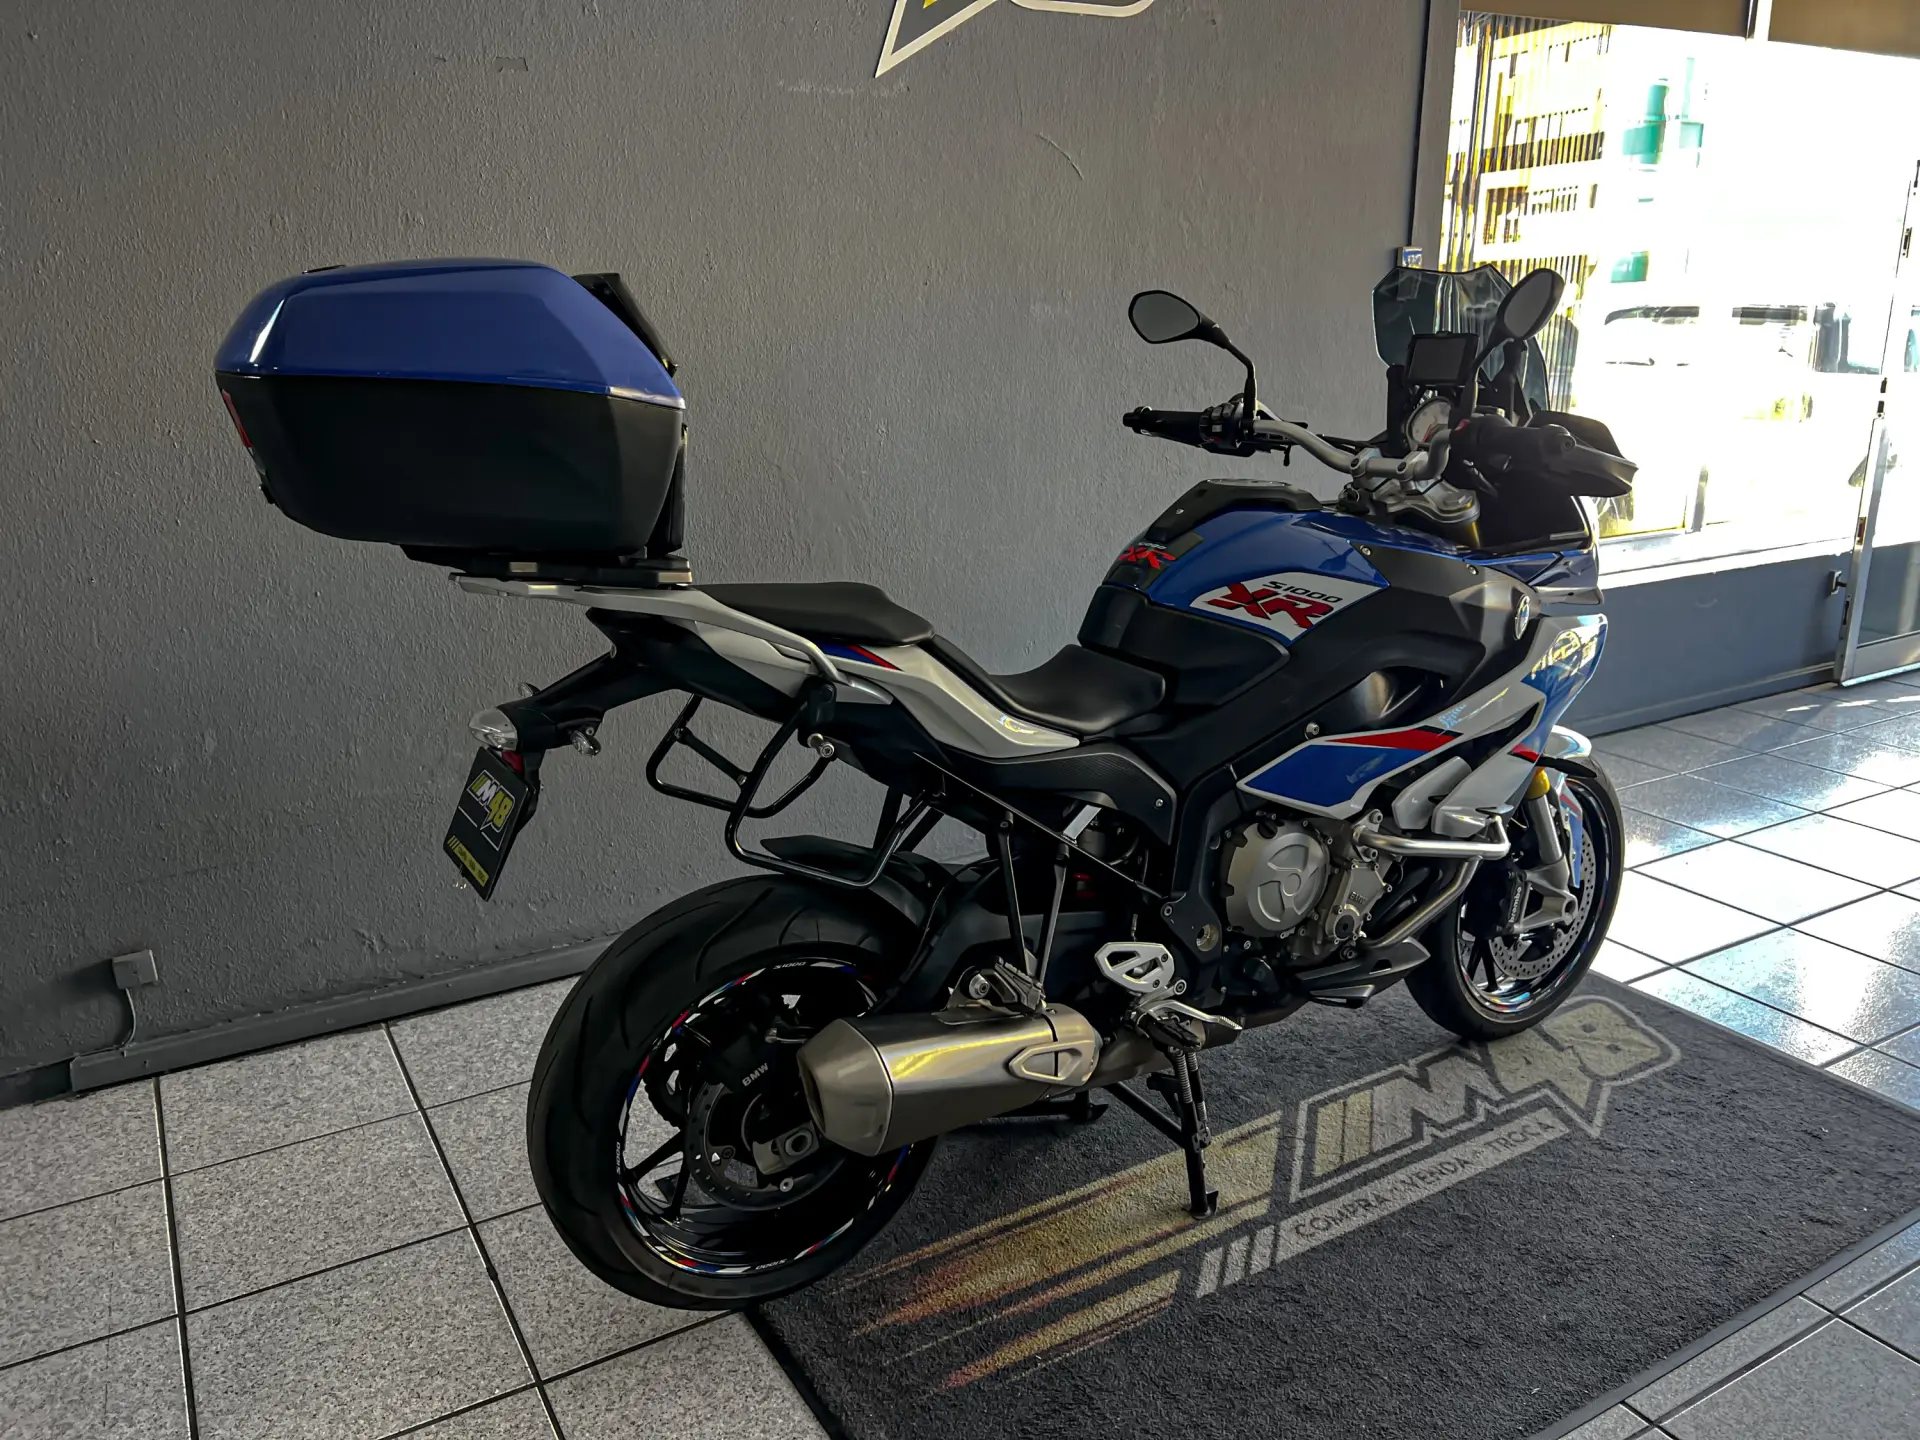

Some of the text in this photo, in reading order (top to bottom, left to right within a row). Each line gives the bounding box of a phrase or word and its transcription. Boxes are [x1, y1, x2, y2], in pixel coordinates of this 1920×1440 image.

[1204, 583, 1335, 629] XR
[1262, 580, 1344, 604] S1000
[1508, 886, 1522, 923] brembo
[742, 1062, 769, 1087] BMW
[1294, 1192, 1386, 1238] COMPRA
[1401, 1155, 1474, 1190] VENDA
